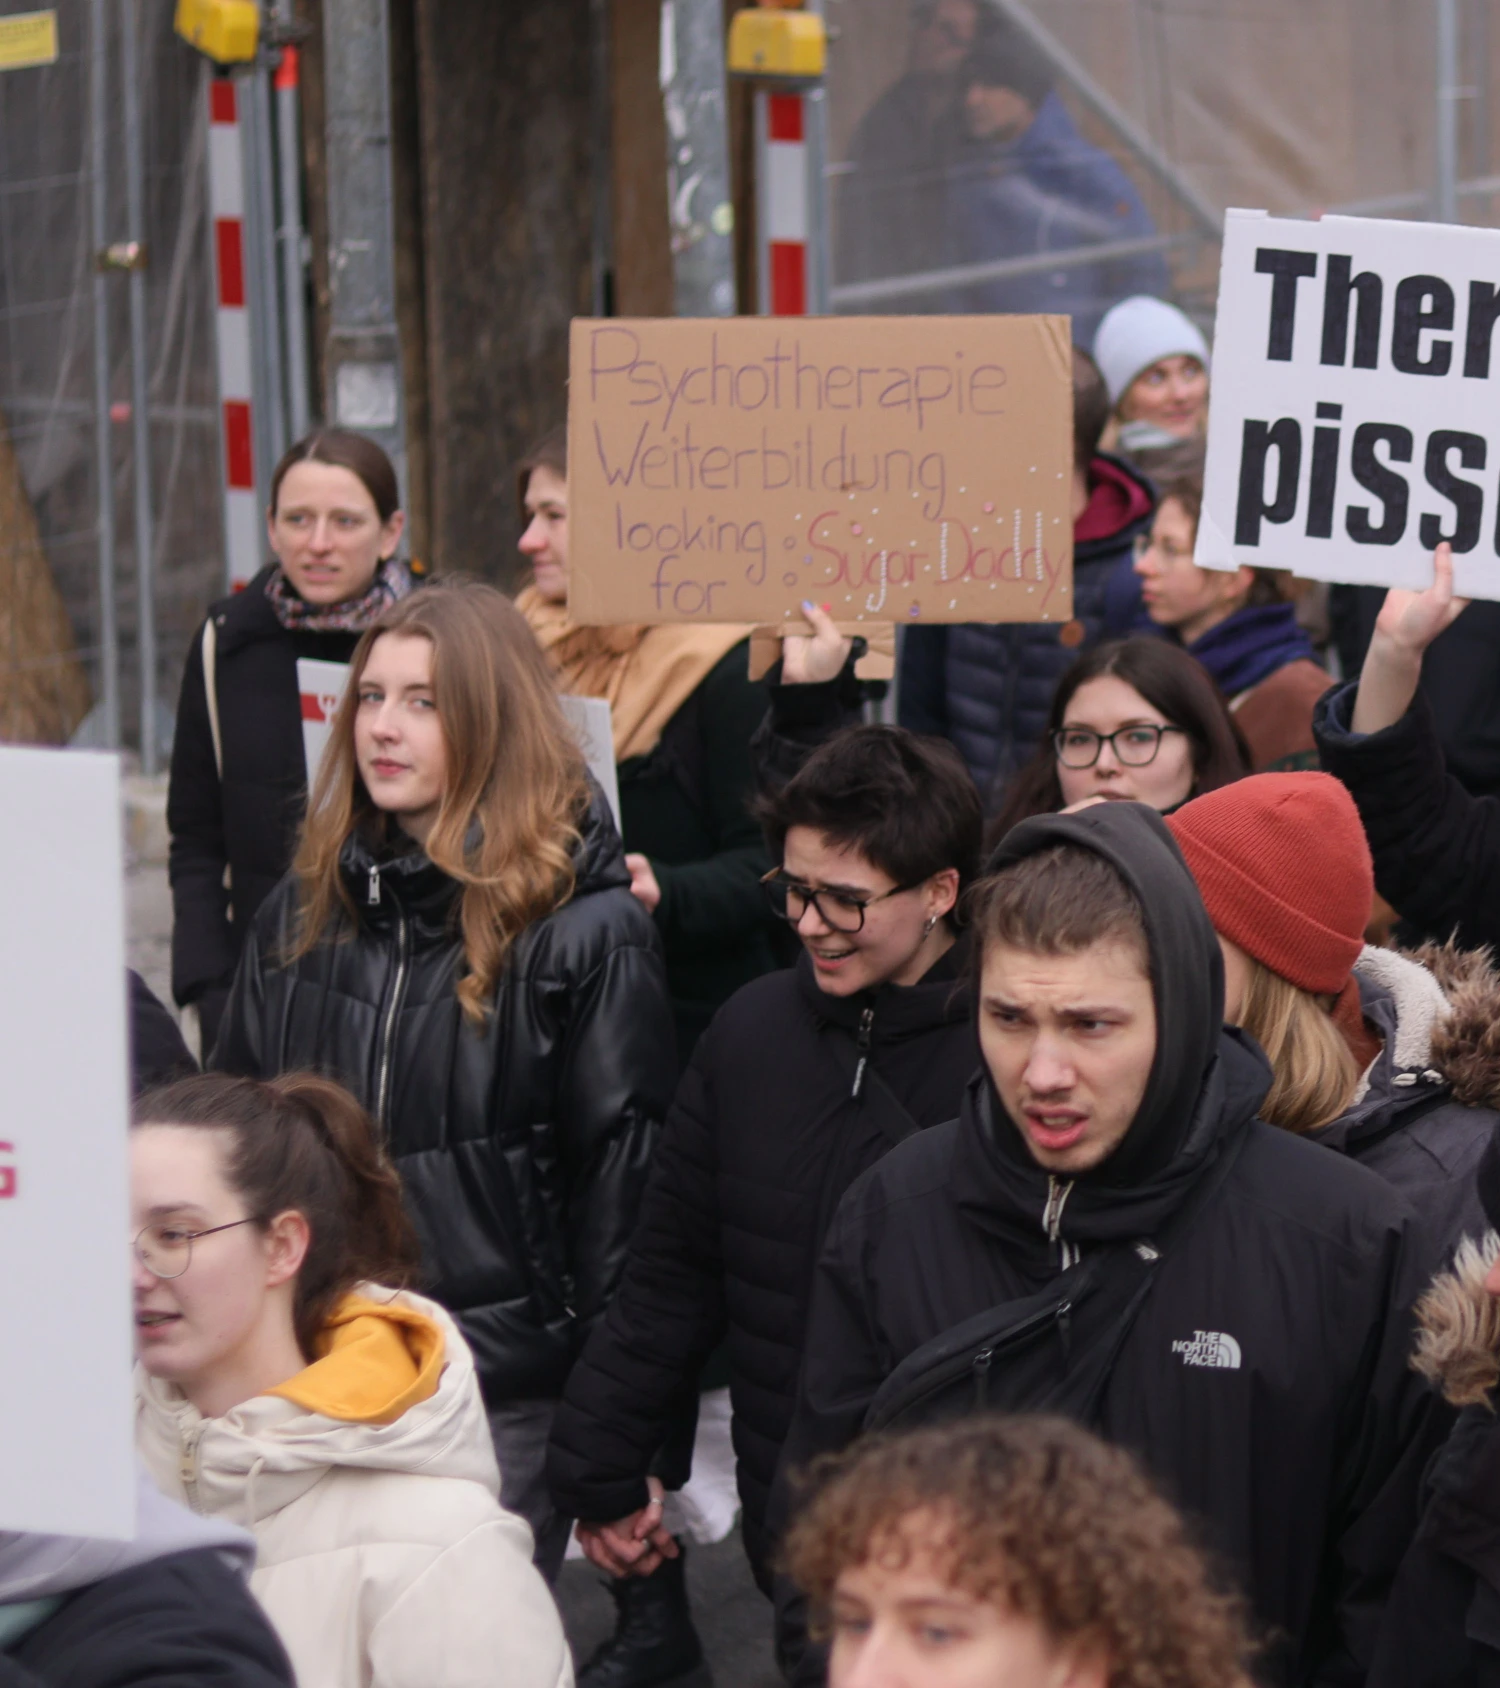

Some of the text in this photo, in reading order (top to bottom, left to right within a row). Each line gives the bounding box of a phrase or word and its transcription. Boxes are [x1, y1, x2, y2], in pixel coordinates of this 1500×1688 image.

[590, 327, 1006, 431] Psychotherapie
[594, 420, 946, 520] Weiterbildung
[617, 502, 766, 585] looking
[808, 510, 929, 612] Sugar
[934, 508, 1066, 611] Daddy
[650, 556, 727, 614] for
[1171, 1340, 1218, 1356] NORTH
[1183, 1353, 1217, 1367] FACE
[1193, 1330, 1220, 1344] THE
